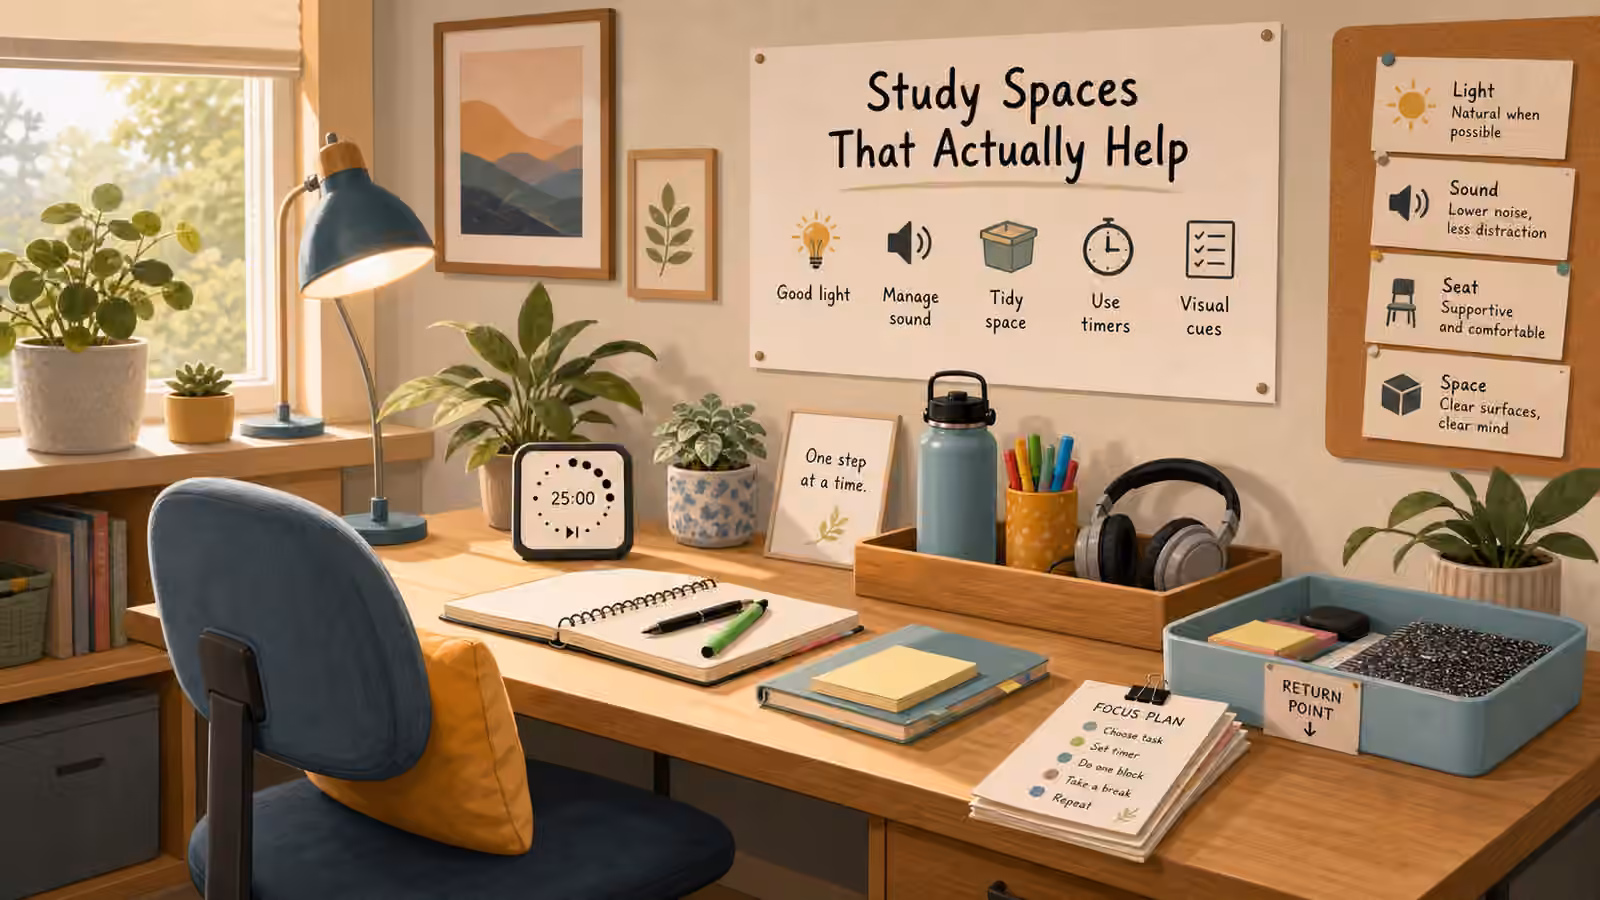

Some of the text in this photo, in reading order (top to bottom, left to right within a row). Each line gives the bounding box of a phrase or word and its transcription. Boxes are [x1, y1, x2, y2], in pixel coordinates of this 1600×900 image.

[867, 66, 1138, 127] Study Spaces
[1454, 81, 1495, 103] Light
[1451, 105, 1540, 121] Natural when
[1450, 123, 1501, 143] possible
[829, 123, 1188, 184] That Actually Help
[1449, 179, 1499, 198] Sound
[1448, 201, 1532, 221] Lower noise,
[1447, 220, 1547, 239] less distraction
[776, 283, 850, 307] Good light
[1441, 276, 1479, 295] Seat
[883, 287, 939, 309] Manage
[990, 289, 1023, 312] Tidy
[1091, 291, 1121, 310] Use
[1179, 295, 1229, 313] Visual
[889, 309, 932, 327] sound
[1440, 299, 1513, 321] Supportive
[985, 317, 1027, 335] space
[1080, 316, 1131, 334] timers
[1186, 324, 1222, 337] cues
[1439, 319, 1546, 340] and comfortable
[1441, 374, 1486, 396] Space
[1439, 396, 1541, 421] Clear surfaces,
[1438, 415, 1509, 435] clear mind
[805, 447, 867, 474] One step
[800, 472, 867, 493] at a time.
[551, 490, 596, 506] 25:00
[1283, 680, 1341, 704] RETURN
[1092, 702, 1186, 727] FOCUS PLAN
[1288, 699, 1335, 721] POINT
[1103, 726, 1164, 745] Choose task
[1089, 742, 1140, 759] Set timer
[1077, 758, 1145, 781] Do one block
[1065, 775, 1089, 789] Take
[1101, 783, 1132, 798] break
[1051, 792, 1092, 811] Repeat
